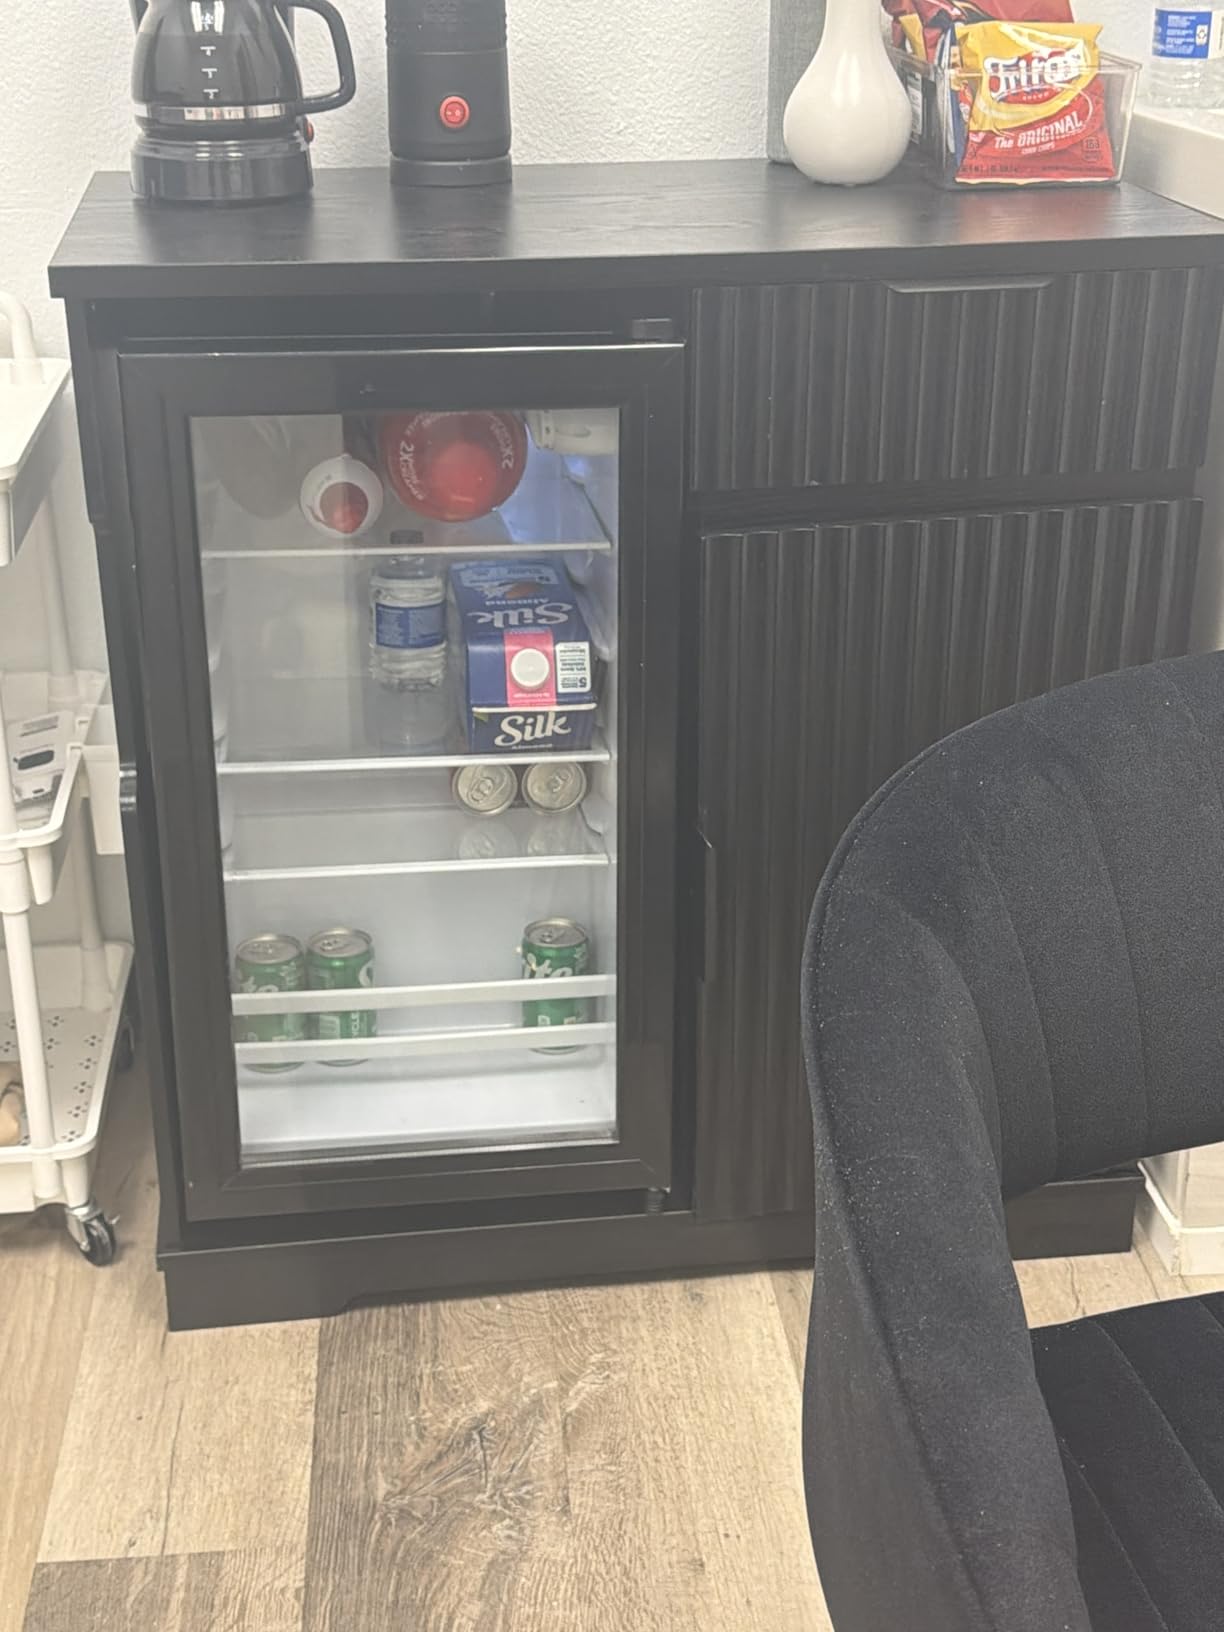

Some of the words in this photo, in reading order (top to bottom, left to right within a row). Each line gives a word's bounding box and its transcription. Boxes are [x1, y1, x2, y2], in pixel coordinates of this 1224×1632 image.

[994, 136, 1014, 149] The
[1017, 111, 1083, 146] ORIGINAL
[467, 601, 573, 629] Silk
[494, 711, 572, 746] Silk
